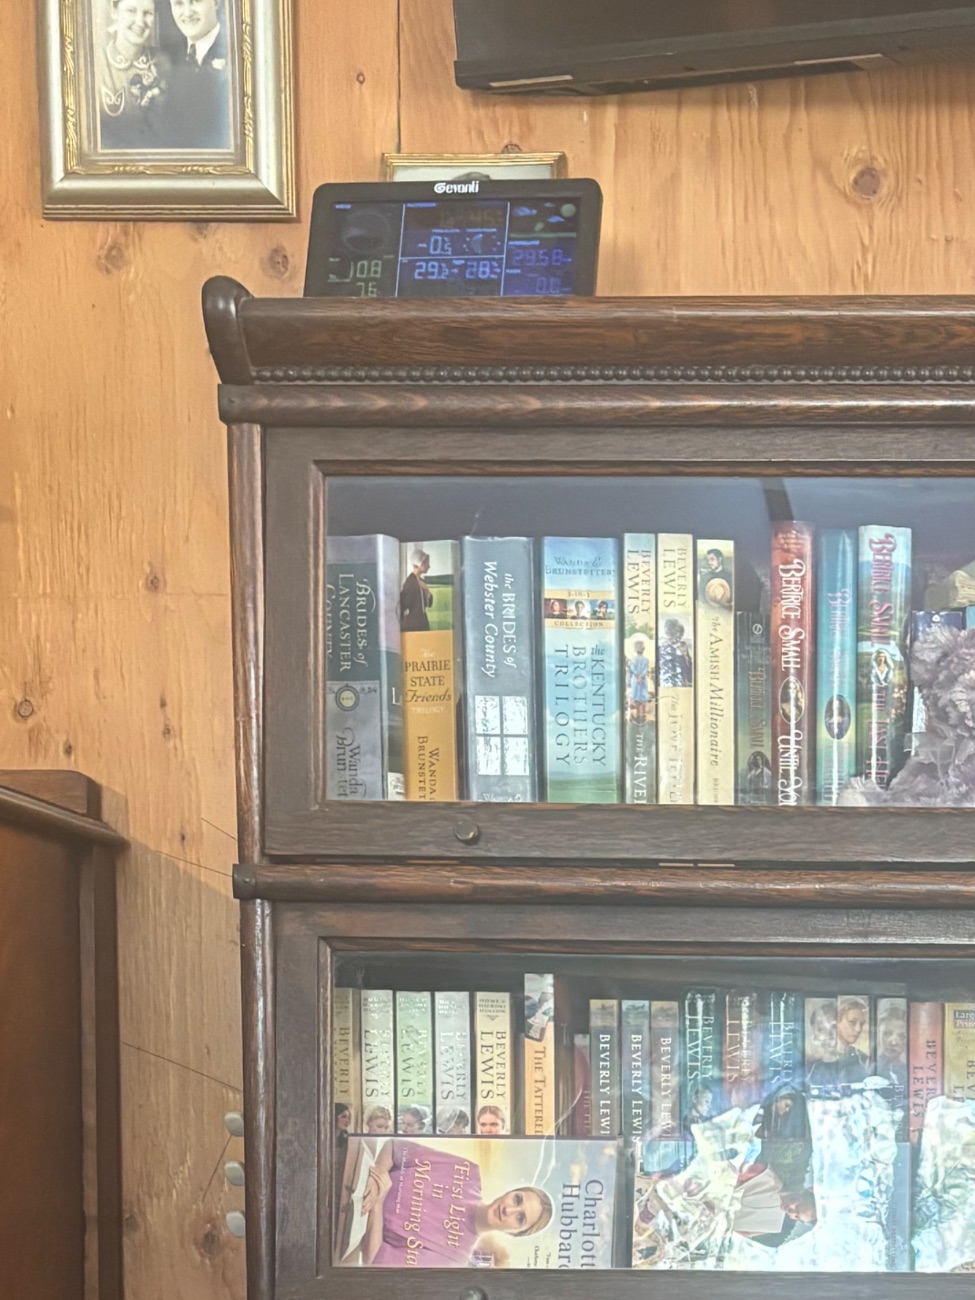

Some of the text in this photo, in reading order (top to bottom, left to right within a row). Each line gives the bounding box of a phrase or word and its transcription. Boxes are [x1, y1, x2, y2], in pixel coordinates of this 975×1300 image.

[627, 550, 639, 614] LEWIS
[640, 550, 651, 614] BEVERLY
[664, 549, 676, 607] LEWIS
[339, 574, 354, 672] LANCASTER
[481, 561, 497, 677] Webster County
[502, 593, 517, 668] BRIDES of
[779, 624, 805, 672] SMALL
[405, 660, 450, 671] PRAIRIE
[410, 676, 445, 687] STATE
[709, 635, 723, 681] AMISH
[406, 689, 451, 703] Friends
[554, 645, 570, 766] TRILOGY
[592, 657, 605, 767] KENTUCKY
[710, 682, 724, 766] Millionaire
[481, 1031, 494, 1099] LEWIS
[496, 1031, 507, 1100] BEVERLY
[535, 1046, 546, 1063] THE
[600, 1034, 610, 1095] BEVERLY
[631, 1034, 642, 1095] BEVERLY
[661, 1037, 672, 1096] BEVERLY
[912, 1066, 924, 1118] LEWIS
[404, 1159, 431, 1232] Morning
[432, 1183, 448, 1198] in
[444, 1162, 470, 1247] First Light
